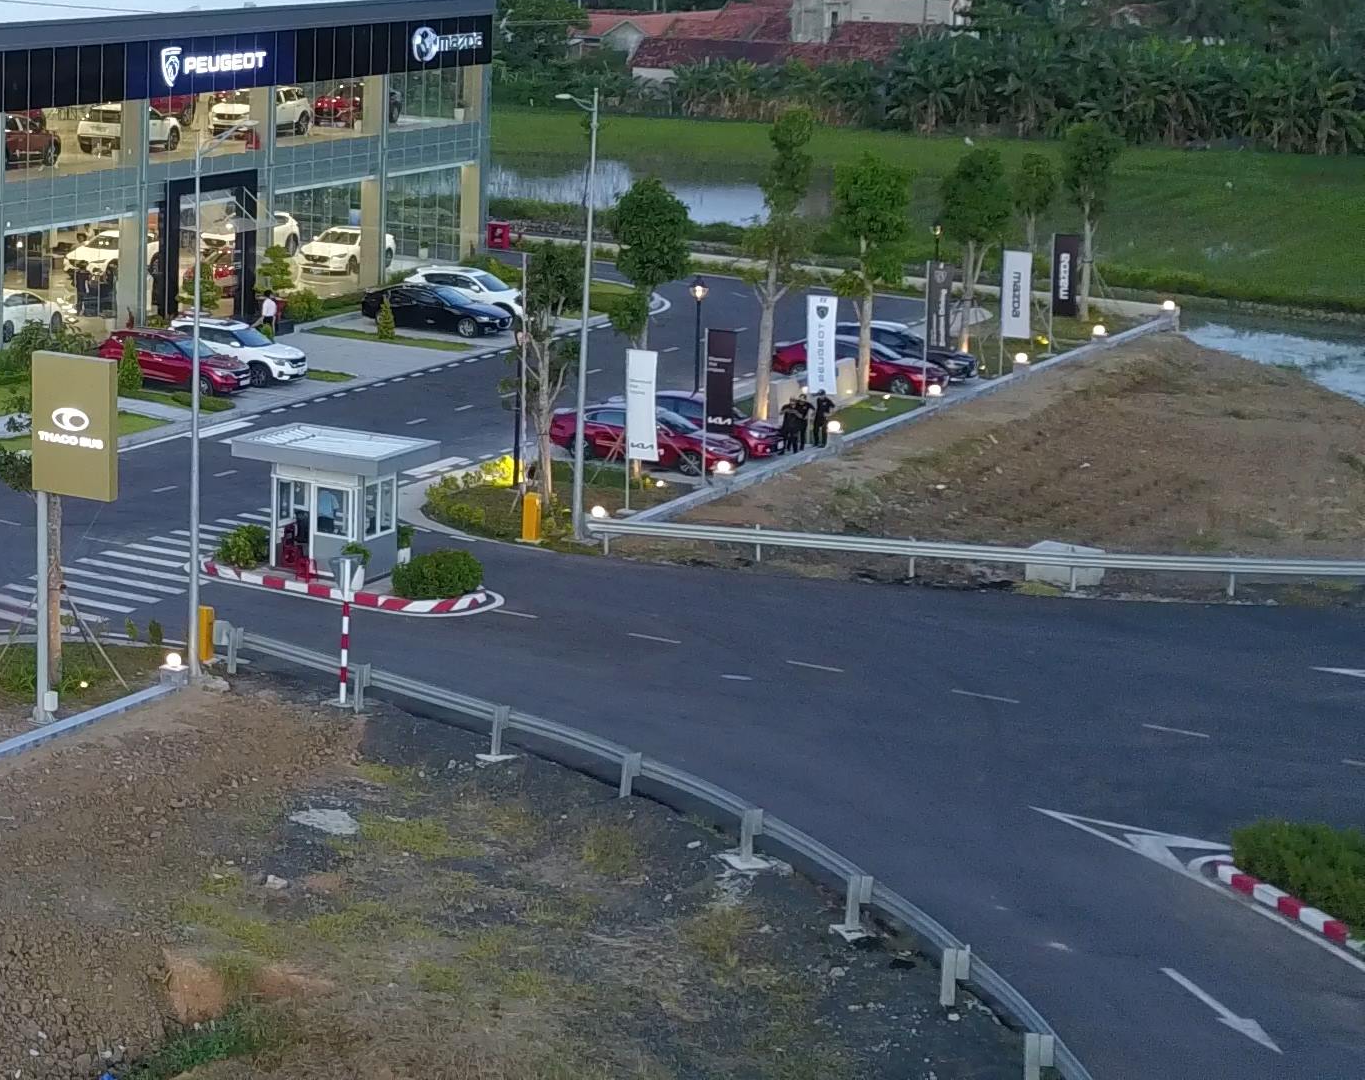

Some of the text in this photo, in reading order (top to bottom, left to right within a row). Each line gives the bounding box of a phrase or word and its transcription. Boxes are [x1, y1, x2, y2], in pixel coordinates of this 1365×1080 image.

[436, 32, 483, 51] mazda
[183, 51, 267, 75] PEUGEOT
[1060, 253, 1070, 300] mazda
[1012, 271, 1021, 318] mazda
[817, 323, 825, 382] PEUGEOT
[707, 416, 732, 425] KIA
[37, 431, 103, 450] THACO BUS
[630, 442, 654, 450] KIA
